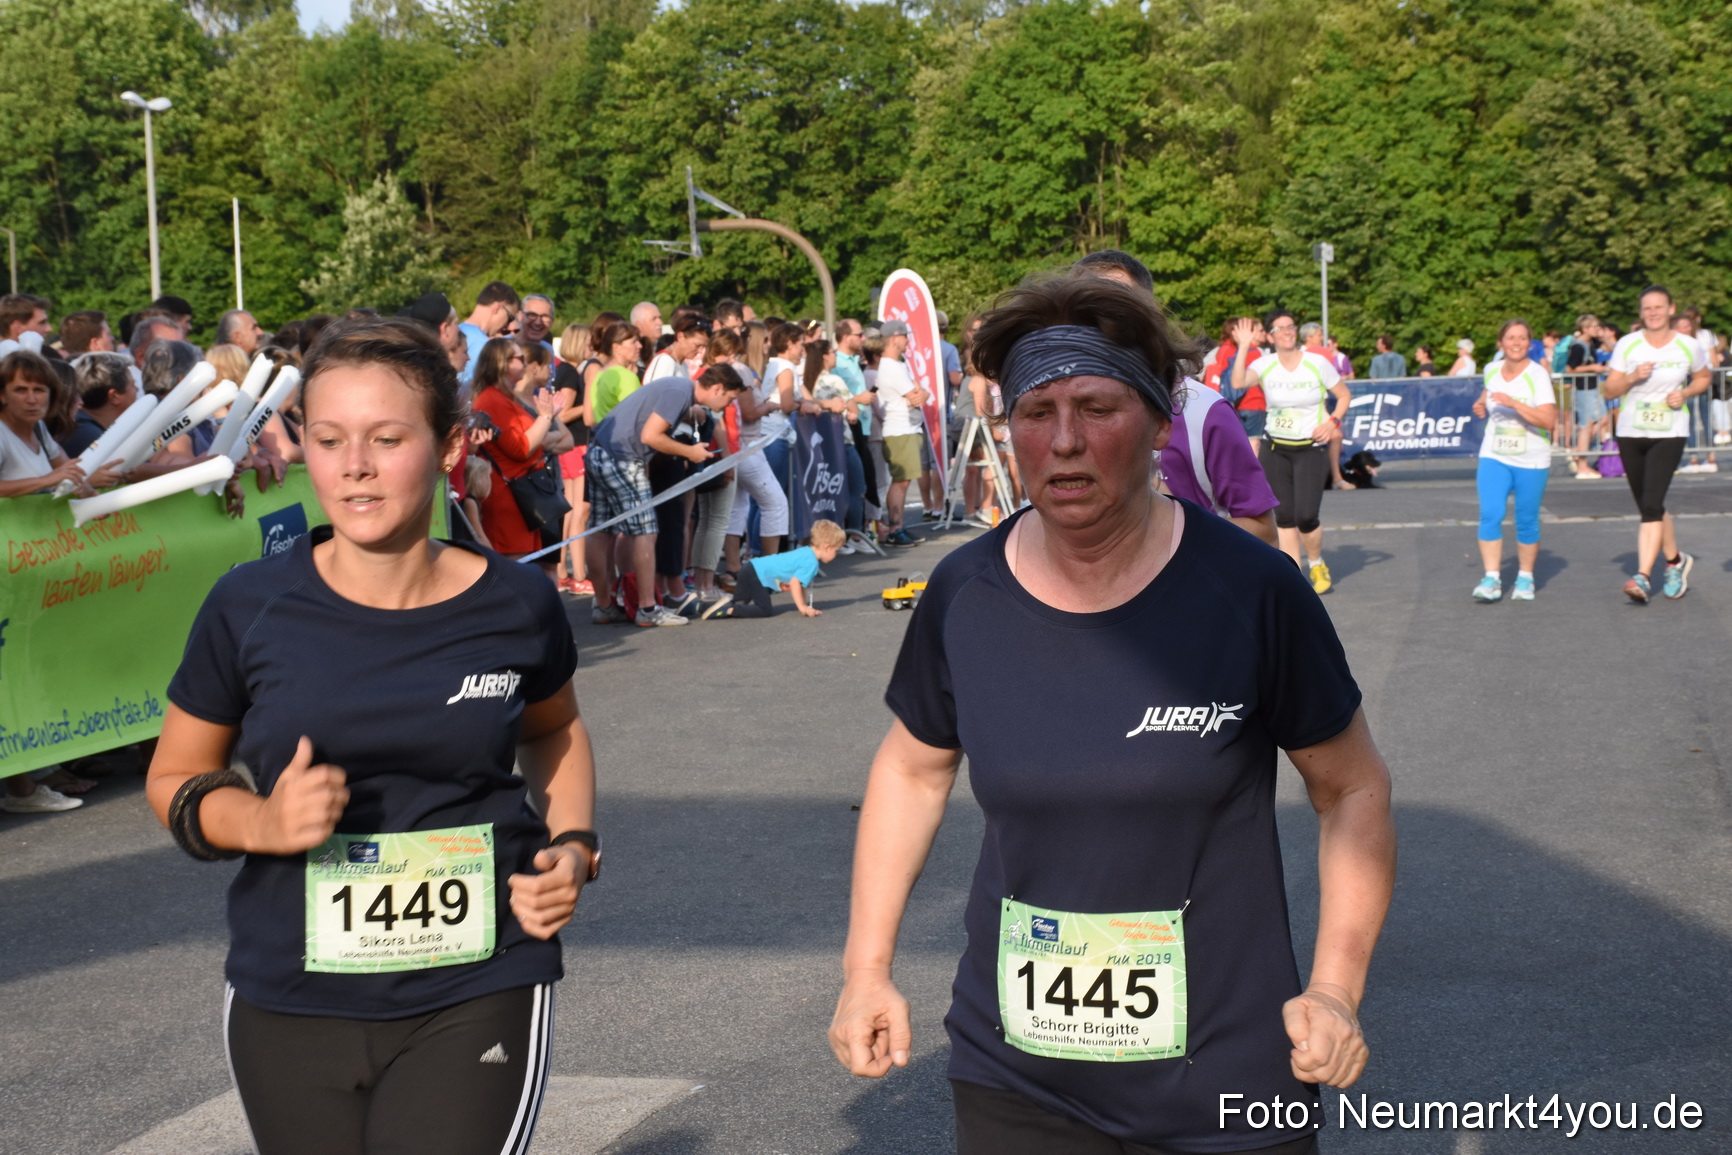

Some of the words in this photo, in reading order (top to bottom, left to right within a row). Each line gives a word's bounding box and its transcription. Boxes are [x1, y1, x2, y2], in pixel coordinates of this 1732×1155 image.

[161, 415, 191, 441] UMS
[251, 407, 273, 436] UMS
[1275, 418, 1294, 429] 922
[1352, 412, 1471, 438] Fischer
[1642, 411, 1664, 422] 921
[1363, 436, 1461, 451] AUTOMOBILE
[8, 519, 85, 574] Gesunde
[41, 562, 103, 610] laufen
[108, 535, 169, 593] länger!
[446, 673, 509, 705] JURA
[1126, 706, 1210, 738] JURA
[332, 879, 469, 932] 1449
[360, 935, 405, 948] Sikora
[410, 932, 443, 945] Lena
[1021, 934, 1089, 956] firmenlauf
[1136, 952, 1171, 965] 2019
[1018, 960, 1159, 1019] 1445
[1023, 1029, 1075, 1045] Lebenshilfe
[1079, 1037, 1127, 1047] Neumarkt
[1142, 1038, 1150, 1046] V
[1031, 1015, 1078, 1033] Schorr
[1083, 1022, 1139, 1038] Brigitte
